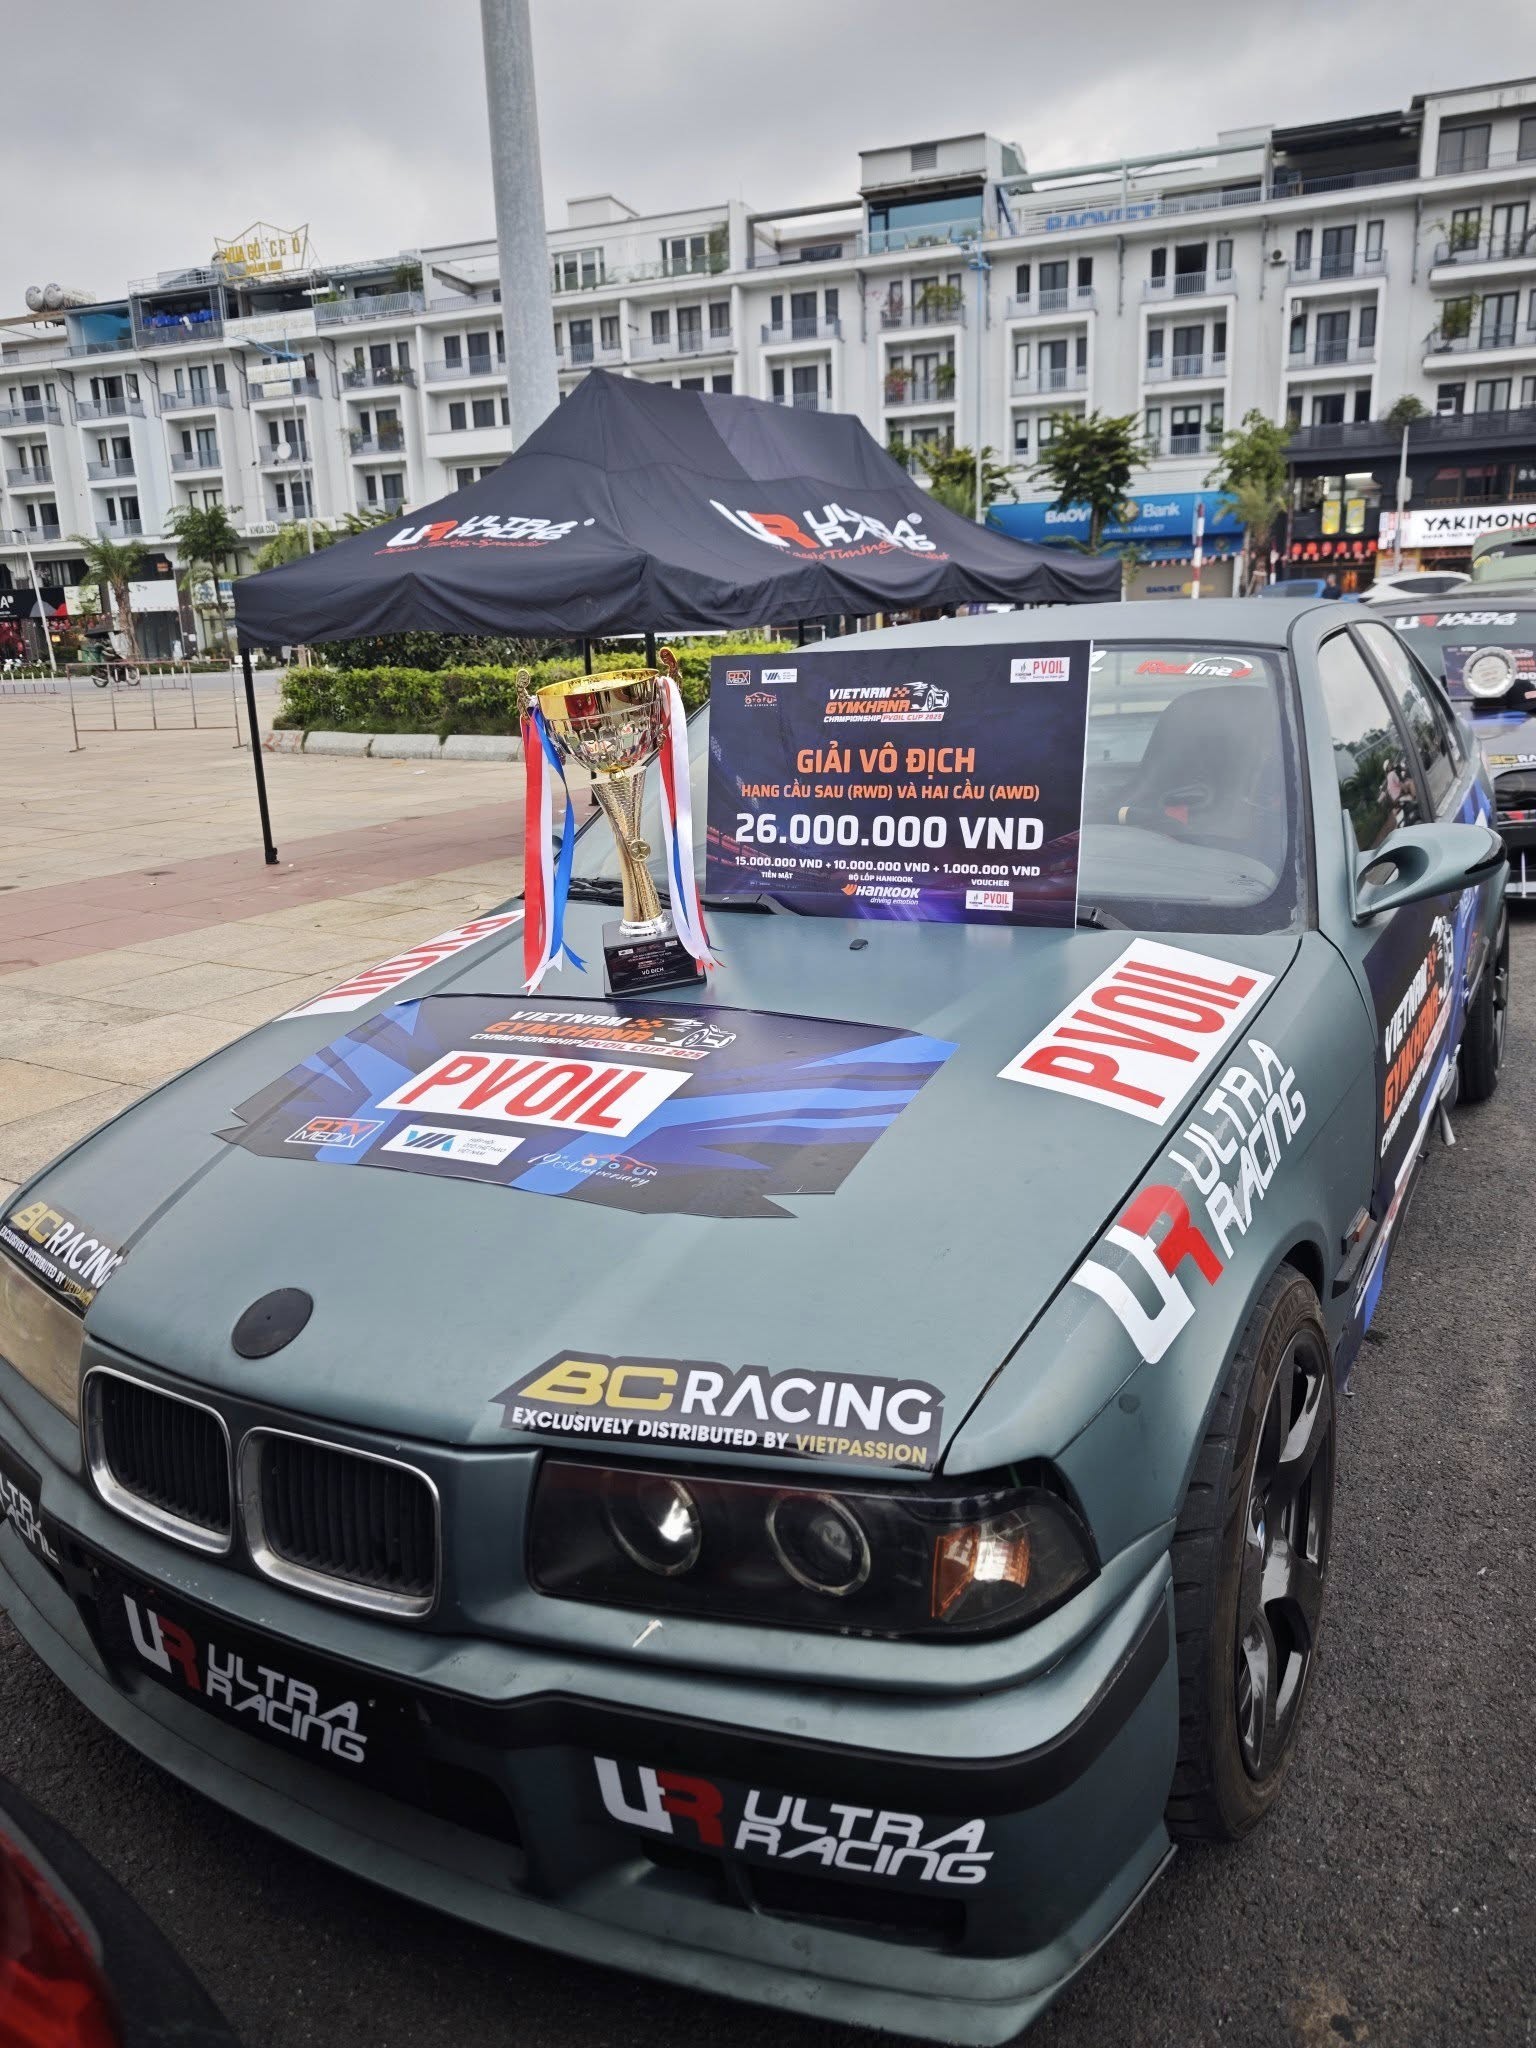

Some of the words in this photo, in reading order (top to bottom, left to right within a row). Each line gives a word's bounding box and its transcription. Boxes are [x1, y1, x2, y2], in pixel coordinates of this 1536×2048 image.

[1143, 502, 1180, 518] Bank
[459, 515, 579, 534] ULTRA
[1032, 660, 1065, 675] PVOIL
[825, 699, 911, 715] GYMKHANA
[829, 687, 892, 700] VIETNAM
[823, 714, 882, 723] CHAMPIONSHIP
[797, 740, 851, 773] GIẢI
[859, 741, 898, 773] VÔ
[905, 747, 976, 780] ĐỊCH
[783, 778, 811, 798] CẦU
[814, 784, 844, 798] SAU
[848, 784, 893, 801] (RWD)
[897, 782, 918, 799] VÀ
[921, 784, 949, 799] HAI
[952, 778, 985, 799] CẦU
[989, 784, 1040, 802] (AWD)
[735, 812, 947, 849] 26.000.000
[958, 816, 1044, 851] VND
[735, 856, 797, 868] 15.000.000
[799, 858, 823, 869] VND
[833, 859, 901, 872] 10.000.000
[904, 862, 930, 873] VND
[943, 863, 1009, 876] 1.000.000
[1011, 865, 1041, 877] VND
[876, 875, 914, 883] HANKOOK
[970, 878, 1010, 887] VOUCHER
[870, 897, 892, 906] driving
[983, 892, 1010, 906] PVOIL
[483, 1021, 654, 1042] GYMKHANA
[508, 1011, 633, 1028] VIETNAM
[469, 1033, 584, 1047] CHAMPIONSHIP
[585, 1039, 628, 1051] PVOIL
[630, 1044, 666, 1056] CUP
[664, 1049, 706, 1060] 2025
[1020, 960, 1259, 1109] PVOIL
[397, 1055, 648, 1129] PVOIL
[1167, 1039, 1285, 1195] ULTRA
[294, 1130, 356, 1147] MEDIA
[1204, 1066, 1307, 1259] RACING
[10, 1201, 65, 1244] BC
[0, 1225, 28, 1255] EXCLUSIVELY
[24, 1247, 58, 1280] DISTRIBUTED
[54, 1271, 67, 1286] BY
[1070, 1184, 1225, 1365] UR
[517, 1359, 679, 1411] BC
[680, 1369, 933, 1436] RACING
[511, 1406, 632, 1436] EXCLUSIVELY
[637, 1421, 758, 1448] DISTRIBUTED
[763, 1432, 790, 1451] BY
[796, 1433, 928, 1465] VIETPASSION
[123, 1593, 201, 1690] UR
[207, 1643, 359, 1731] ULTRA
[205, 1669, 368, 1763] RACING
[594, 1755, 725, 1848] UR
[743, 1789, 987, 1853] ULTRA
[734, 1820, 995, 1885] RACING
